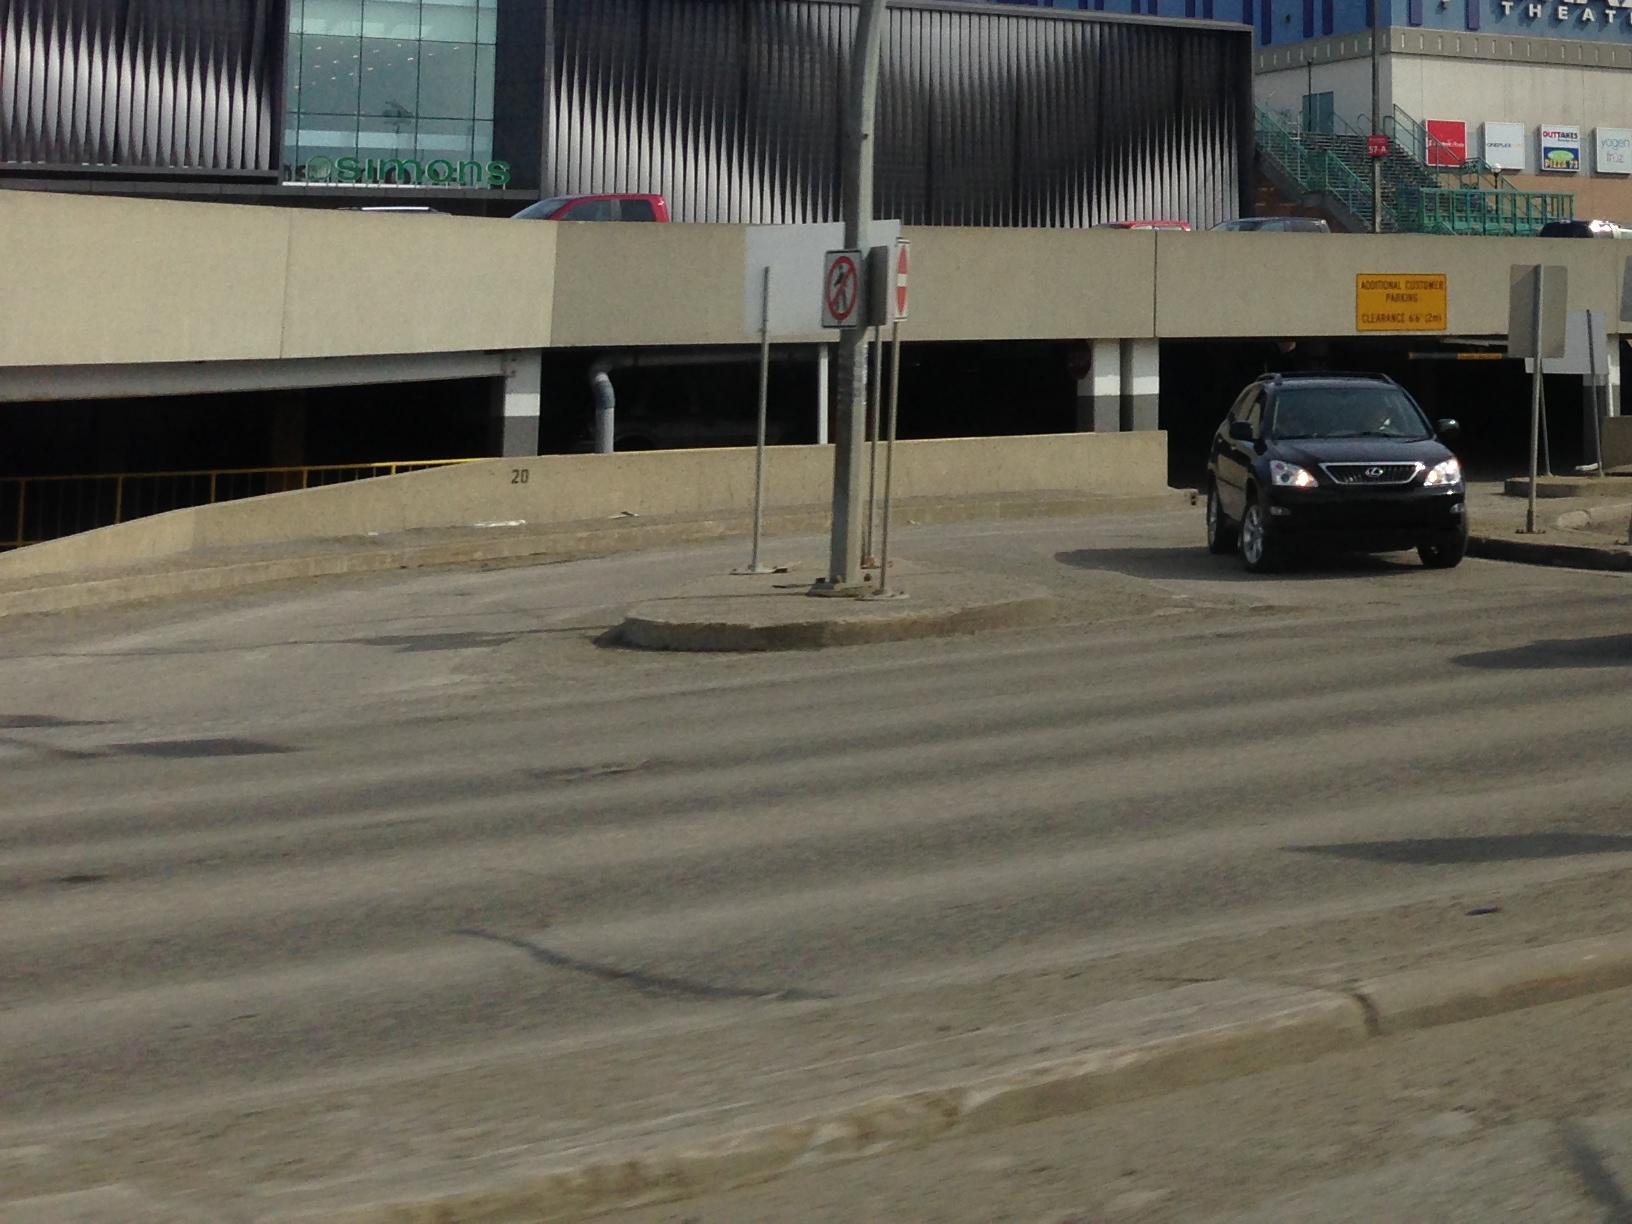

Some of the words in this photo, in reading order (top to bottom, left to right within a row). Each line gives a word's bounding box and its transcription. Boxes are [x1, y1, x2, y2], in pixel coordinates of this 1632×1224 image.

[1602, 138, 1630, 152] yogen
[335, 155, 512, 186] simons
[1385, 293, 1418, 302] PARKING
[1361, 313, 1406, 323] CLEARANCE
[511, 468, 530, 485] 20
